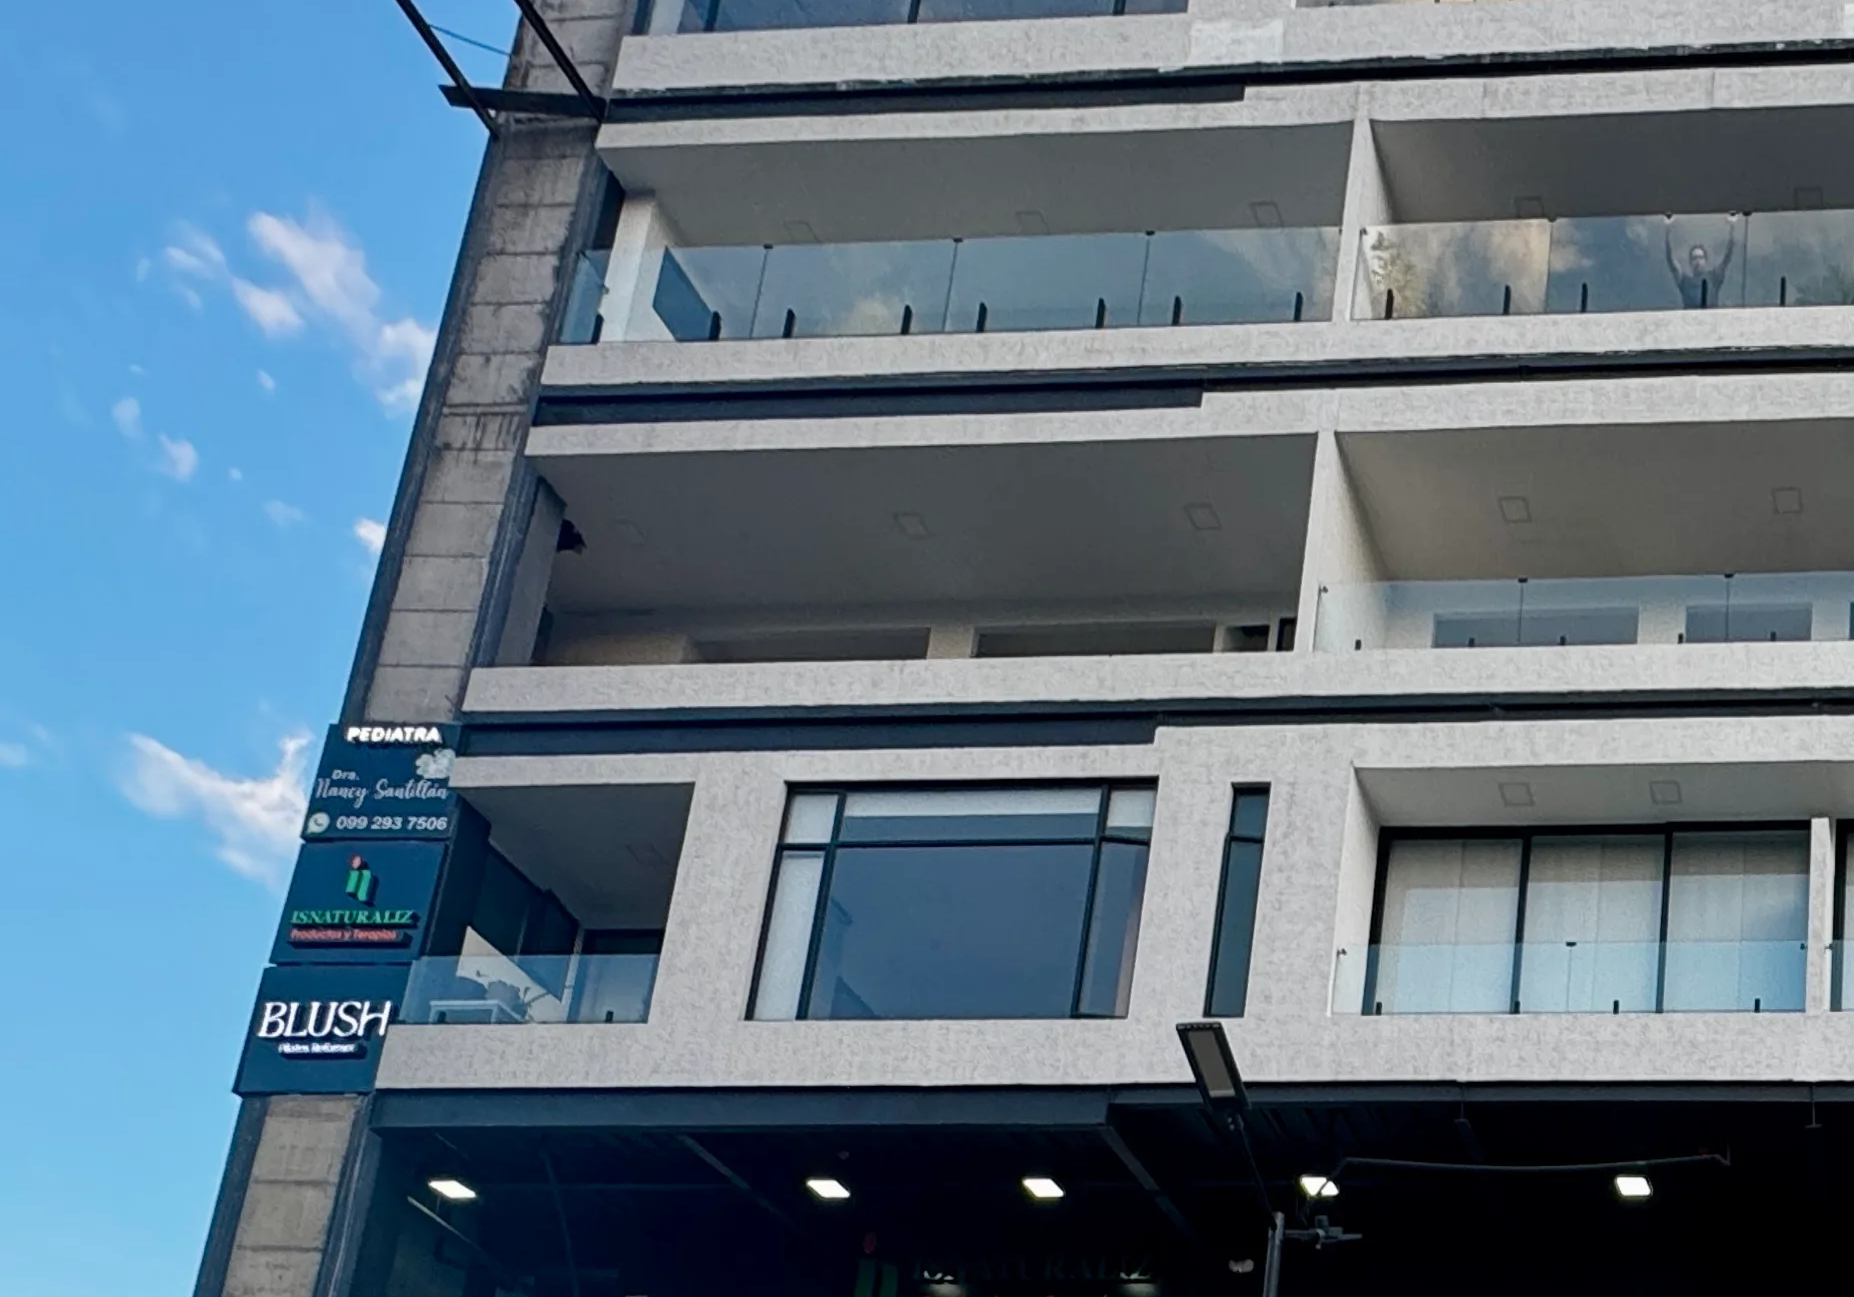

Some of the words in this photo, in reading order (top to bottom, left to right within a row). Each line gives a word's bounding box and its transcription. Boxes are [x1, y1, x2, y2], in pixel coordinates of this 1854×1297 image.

[345, 725, 442, 743] PEDIATRA
[331, 769, 360, 781] Dra.
[315, 778, 368, 809] Nancy
[335, 815, 369, 830] 099
[370, 816, 404, 830] 293
[407, 816, 449, 831] 7506
[290, 909, 414, 925] ISNATURALIZ
[257, 1000, 392, 1037] BLUSH
